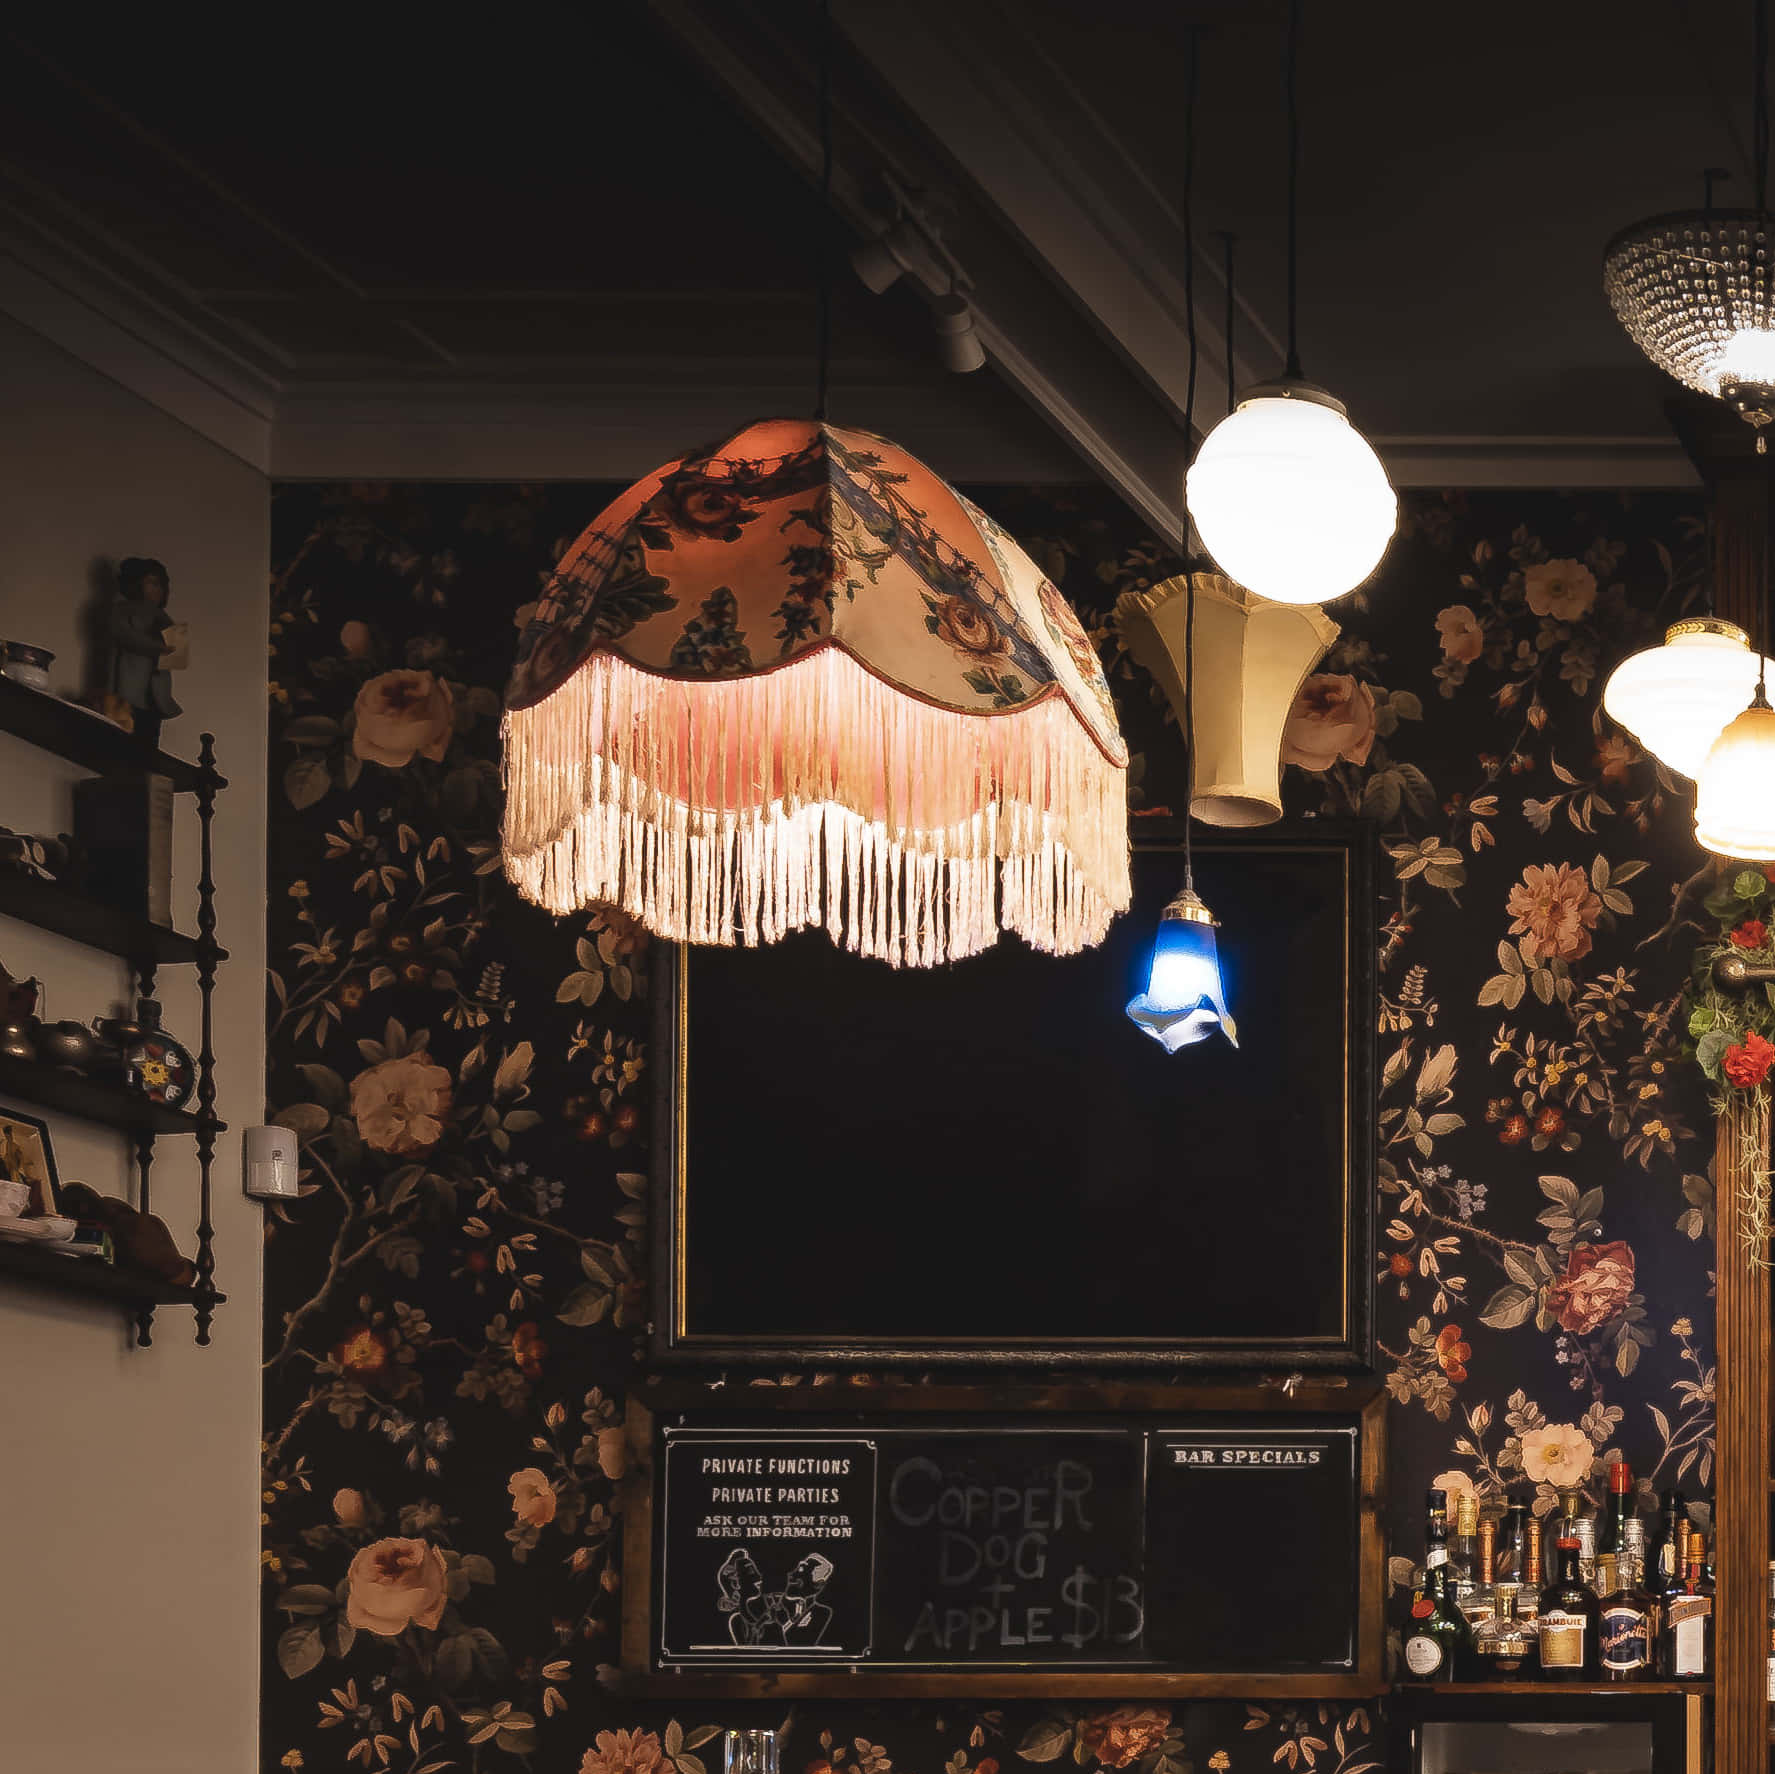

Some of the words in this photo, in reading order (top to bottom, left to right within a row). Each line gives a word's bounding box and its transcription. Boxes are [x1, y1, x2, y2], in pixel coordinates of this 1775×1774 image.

[1174, 1450, 1216, 1463] BAR
[1222, 1450, 1320, 1464] SPECIALS
[702, 1458, 763, 1474] PRIVATE
[769, 1458, 851, 1475] FUNCTIONS
[711, 1487, 772, 1503] PRIVATE
[777, 1487, 840, 1503] PARTIES
[889, 1456, 1094, 1531] COPPER
[703, 1515, 732, 1525] ASK
[737, 1515, 769, 1525] OUR
[771, 1514, 814, 1525] TEAM
[819, 1515, 850, 1525] FOR
[697, 1526, 742, 1537] MORE
[746, 1526, 852, 1537] INFORMATION
[938, 1531, 1049, 1586] DOG
[903, 1600, 1054, 1652] APPLE
[1061, 1564, 1145, 1649] $13
